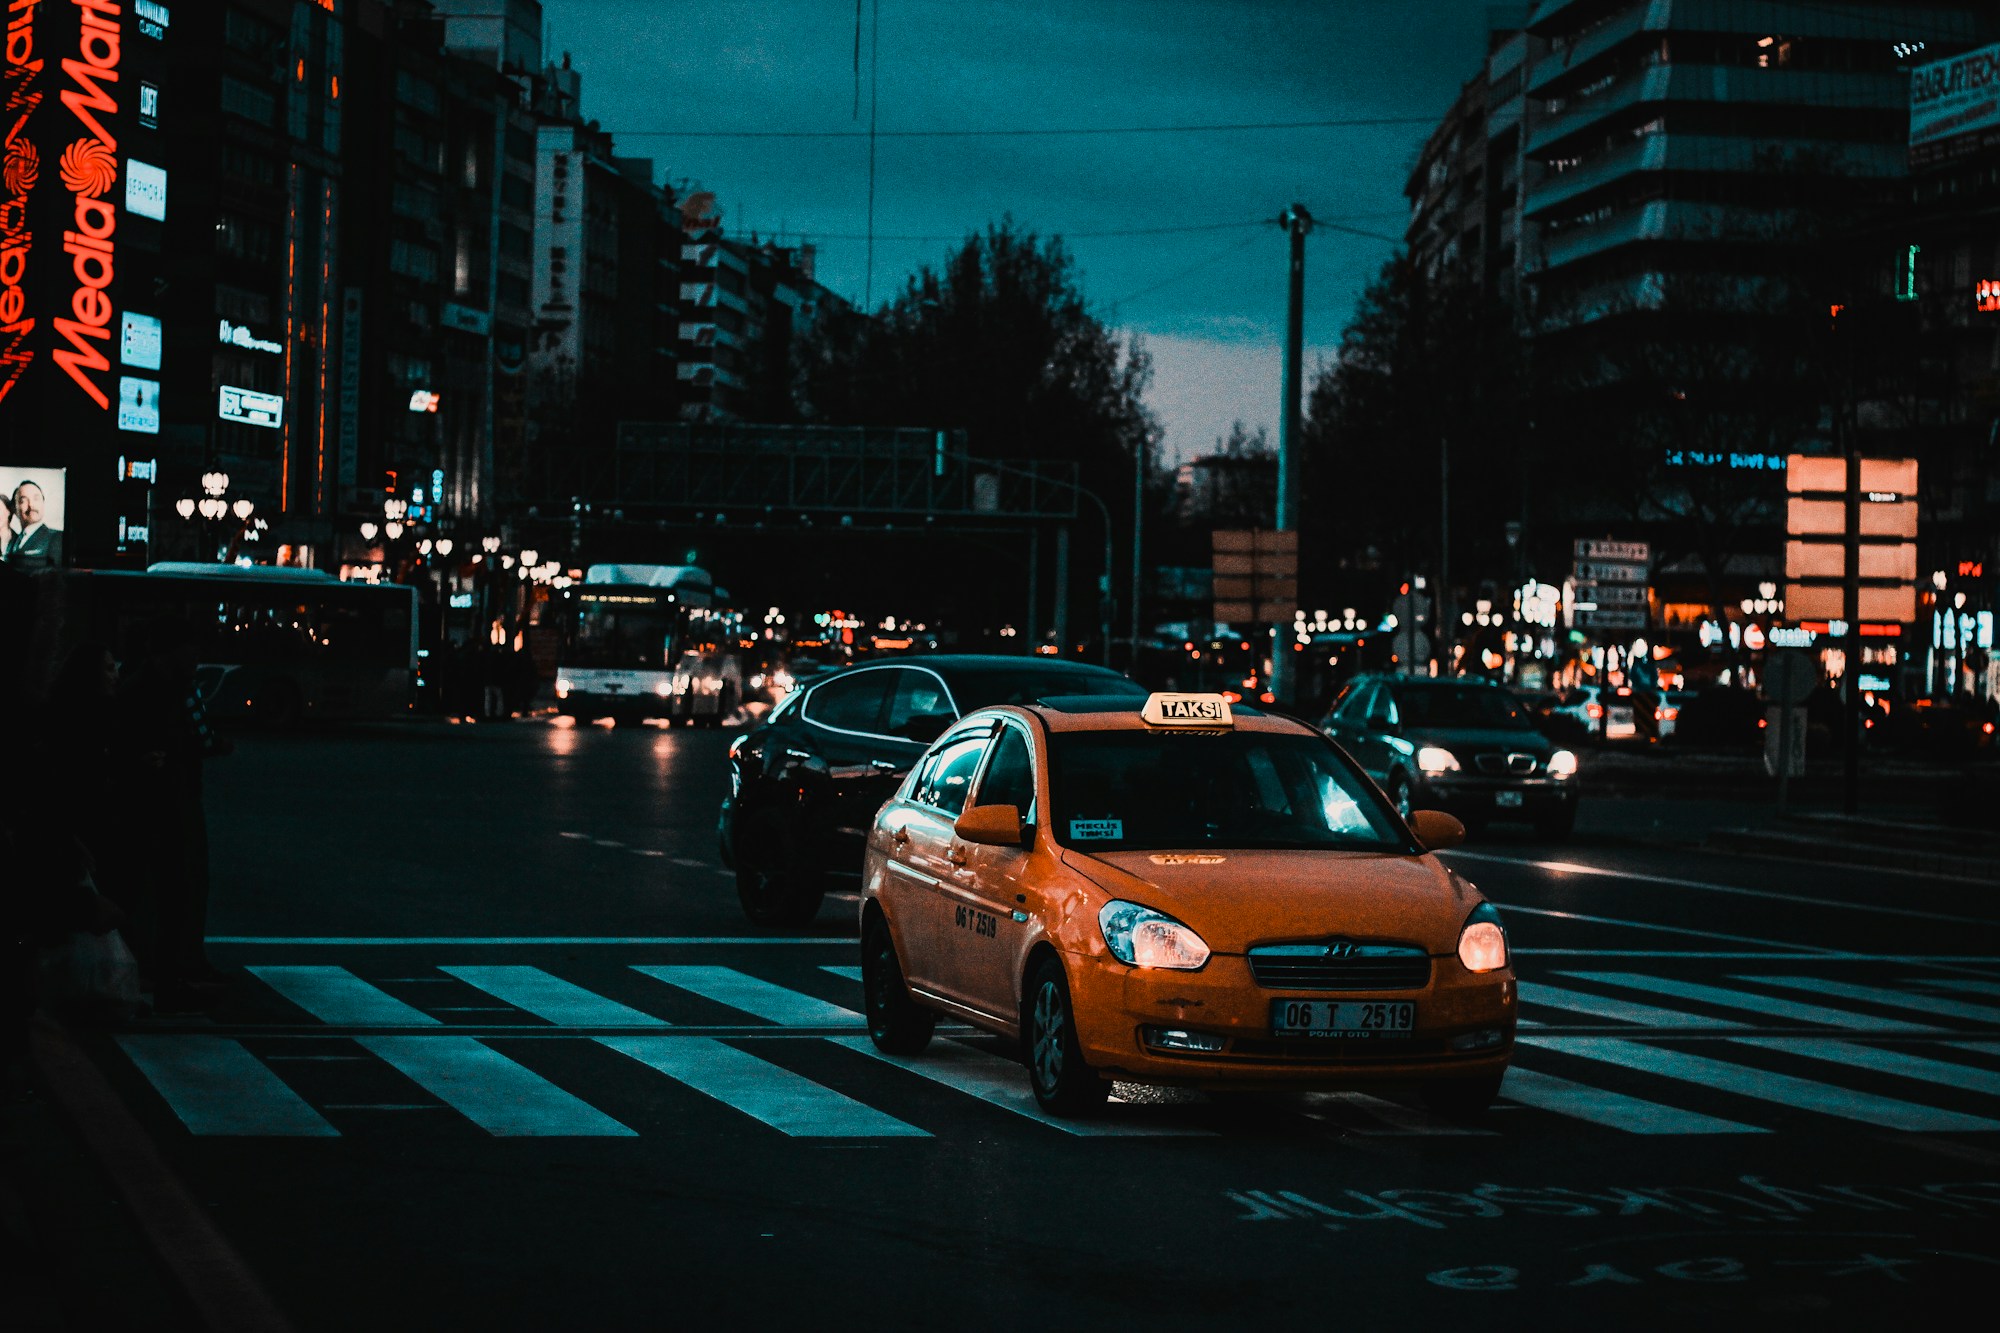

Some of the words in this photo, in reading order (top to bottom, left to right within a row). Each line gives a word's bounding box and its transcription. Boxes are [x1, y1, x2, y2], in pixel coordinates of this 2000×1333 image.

[956, 905, 966, 928] 06
[969, 909, 975, 930] T
[976, 911, 996, 938] 2519
[1286, 1003, 1312, 1027] 06
[1327, 1004, 1339, 1027] T
[1361, 1004, 1411, 1028] 2519
[1309, 1030, 1343, 1038] POLAT
